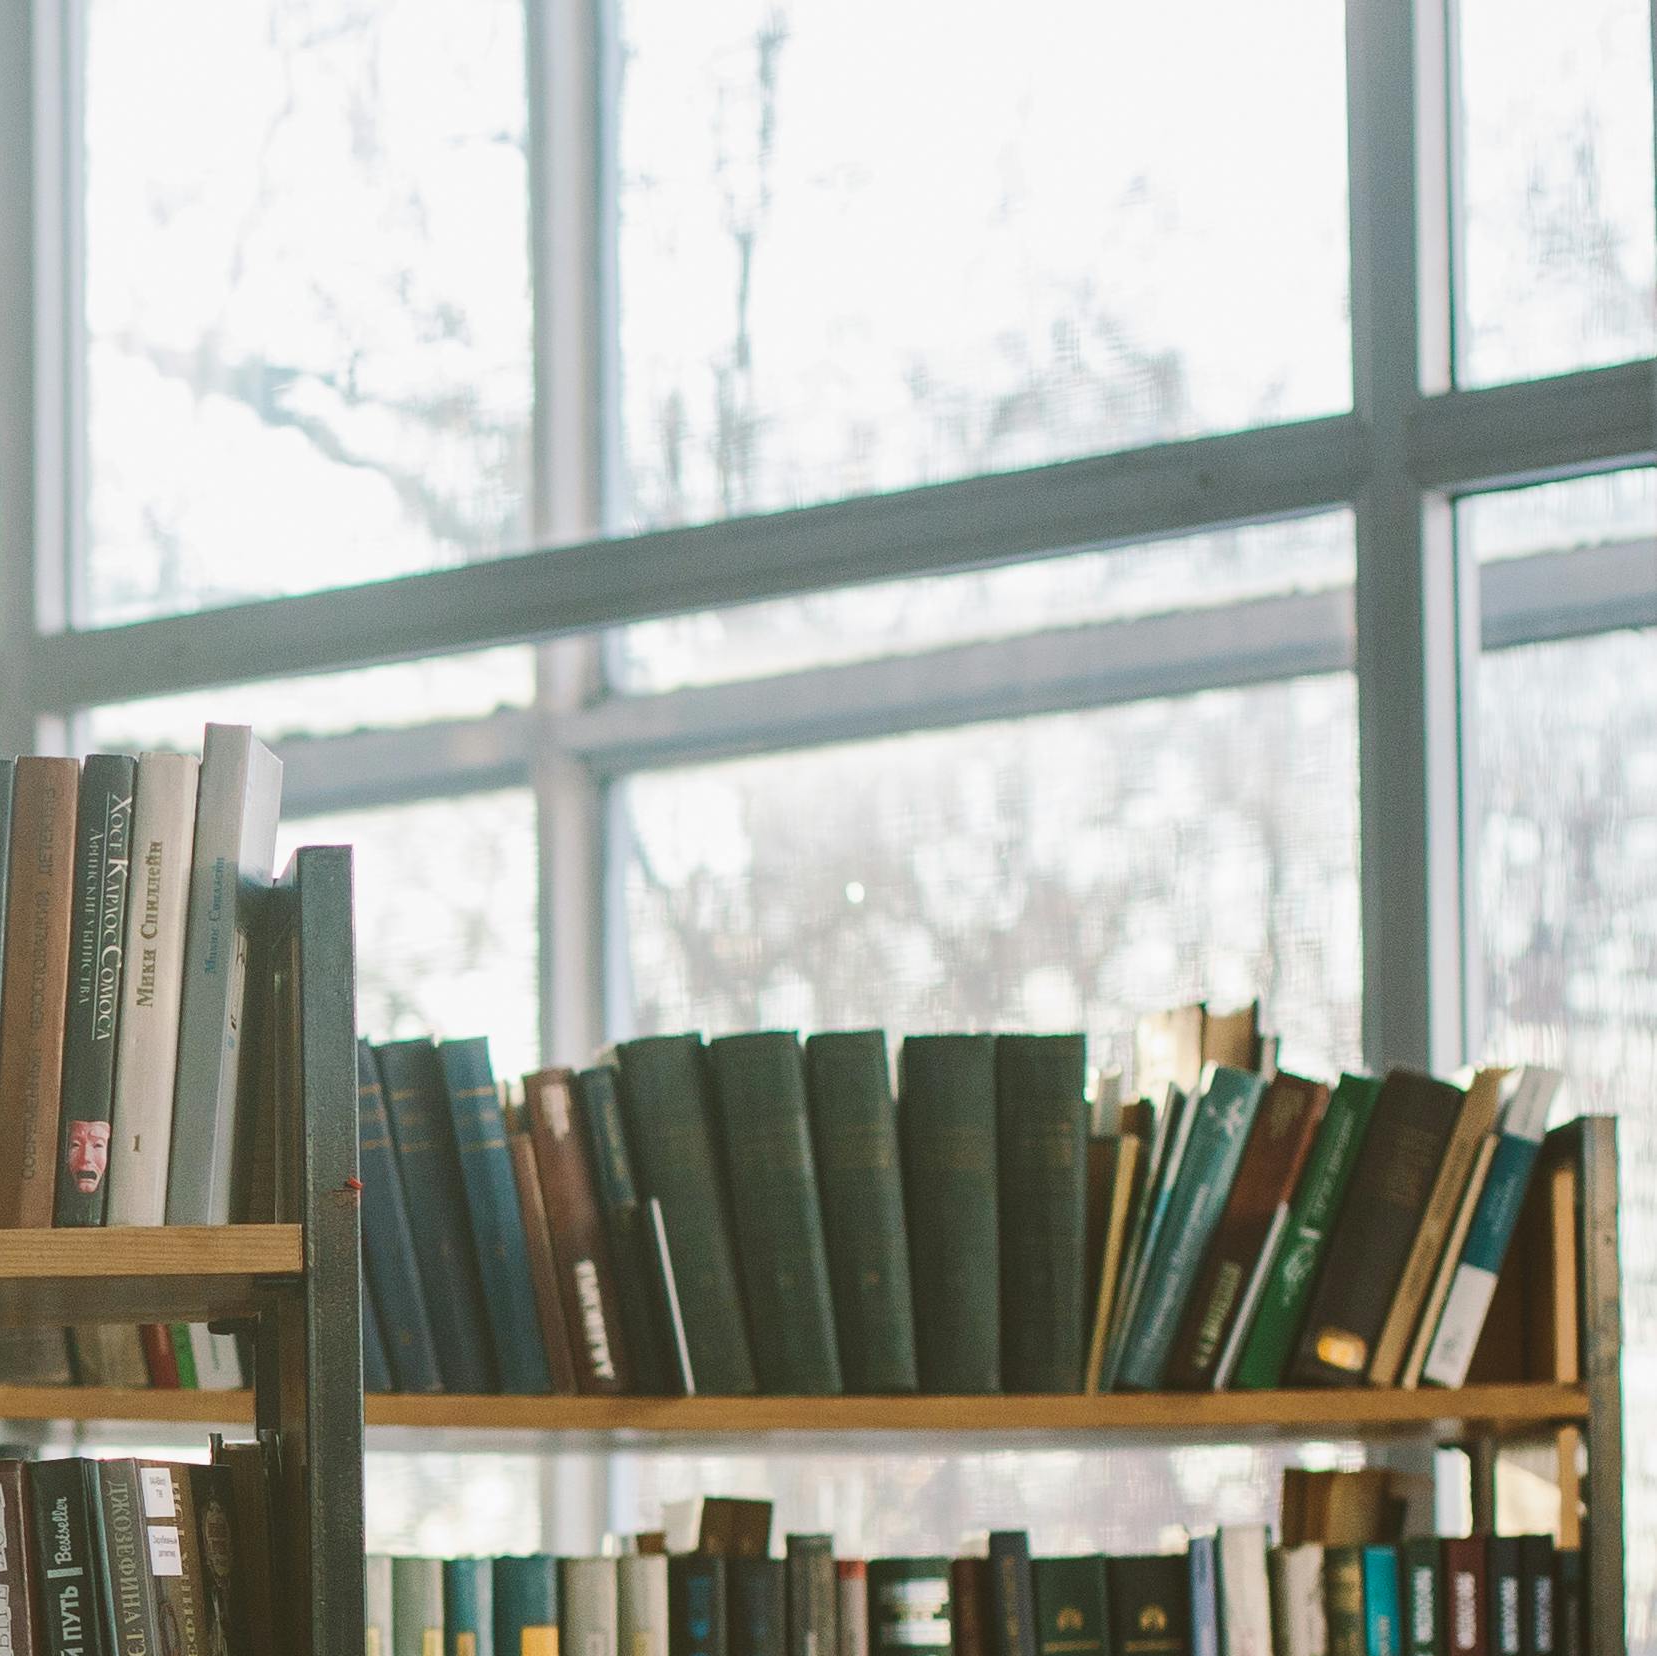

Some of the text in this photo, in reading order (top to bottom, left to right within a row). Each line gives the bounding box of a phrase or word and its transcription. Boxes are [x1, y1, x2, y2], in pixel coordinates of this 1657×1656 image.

[136, 842, 163, 1007] Мики Спиллейн
[52, 1498, 73, 1565] Bestseller
[59, 1586, 82, 1640] ПУТЬ
